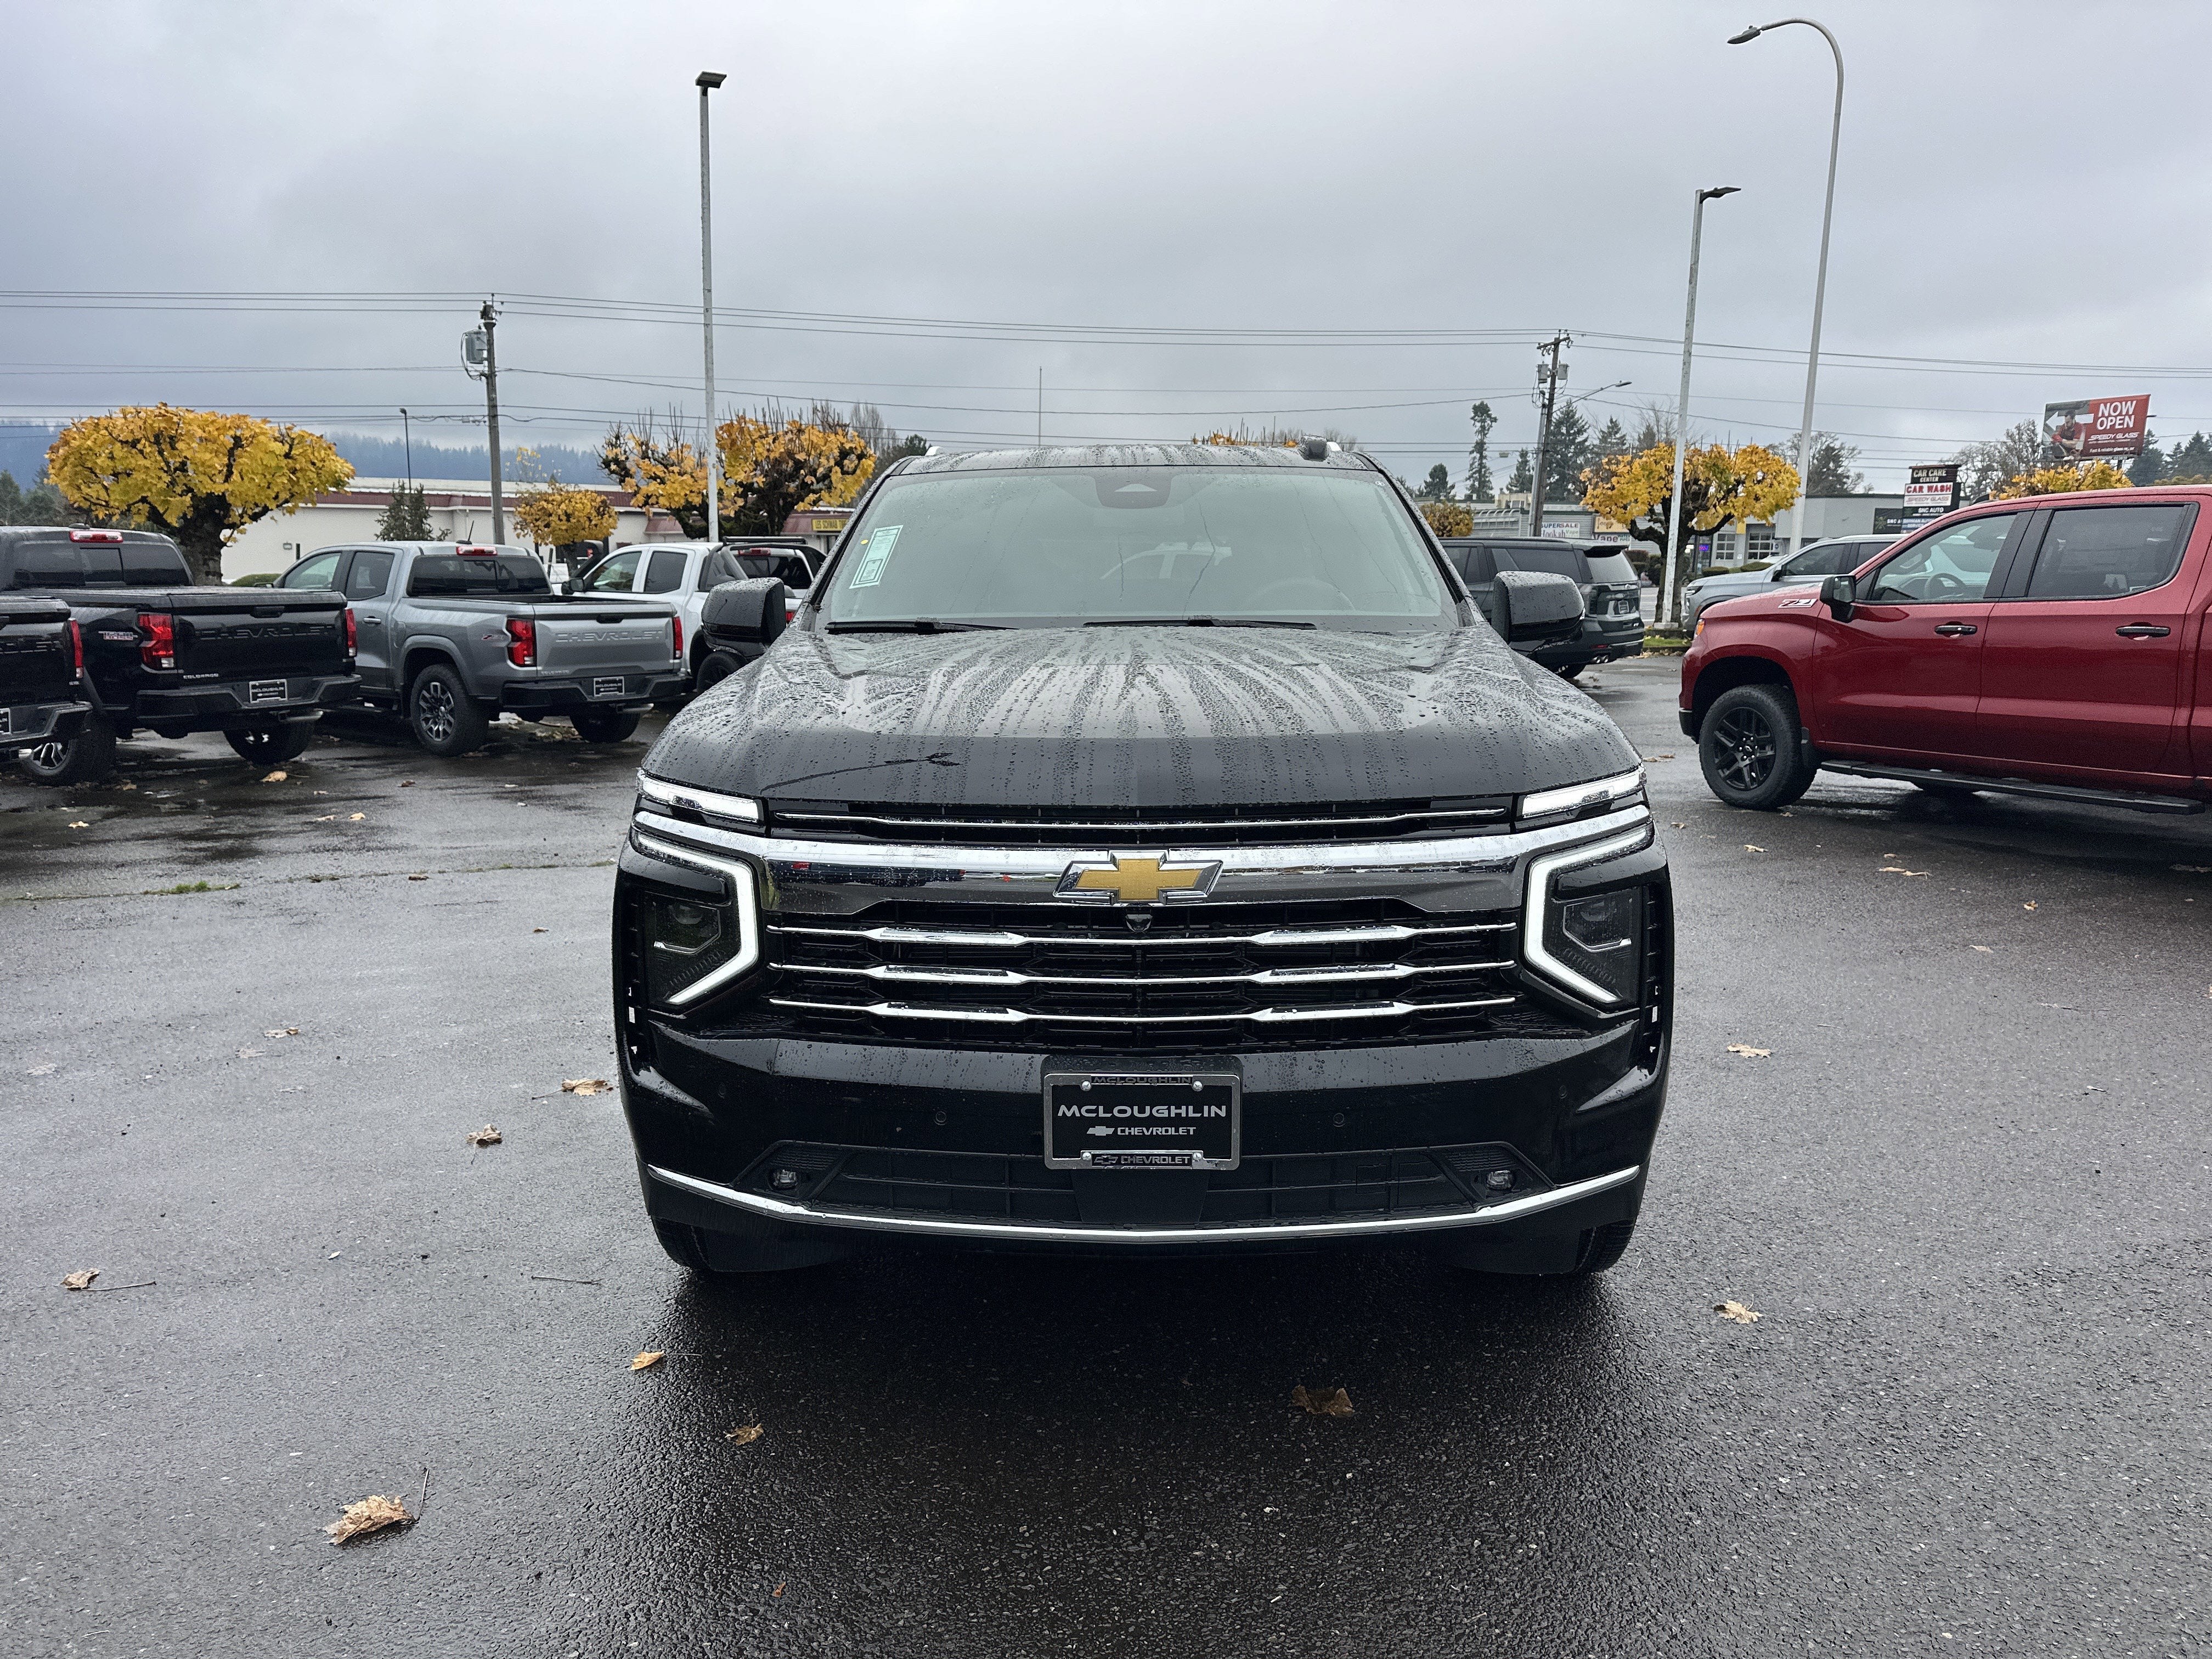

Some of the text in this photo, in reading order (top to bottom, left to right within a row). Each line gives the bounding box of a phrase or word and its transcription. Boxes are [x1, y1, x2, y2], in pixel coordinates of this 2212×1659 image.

[2098, 400, 2137, 417] NOW
[2096, 415, 2135, 430] OPEN
[1913, 469, 1927, 477] CAR
[1927, 484, 1952, 493] WASH
[555, 630, 663, 642] CHEVROLET
[1057, 1105, 1226, 1118] MCLOUGHLIN
[1117, 1127, 1197, 1135] CHEVROLET
[1121, 1155, 1190, 1164] CHEVROLET
